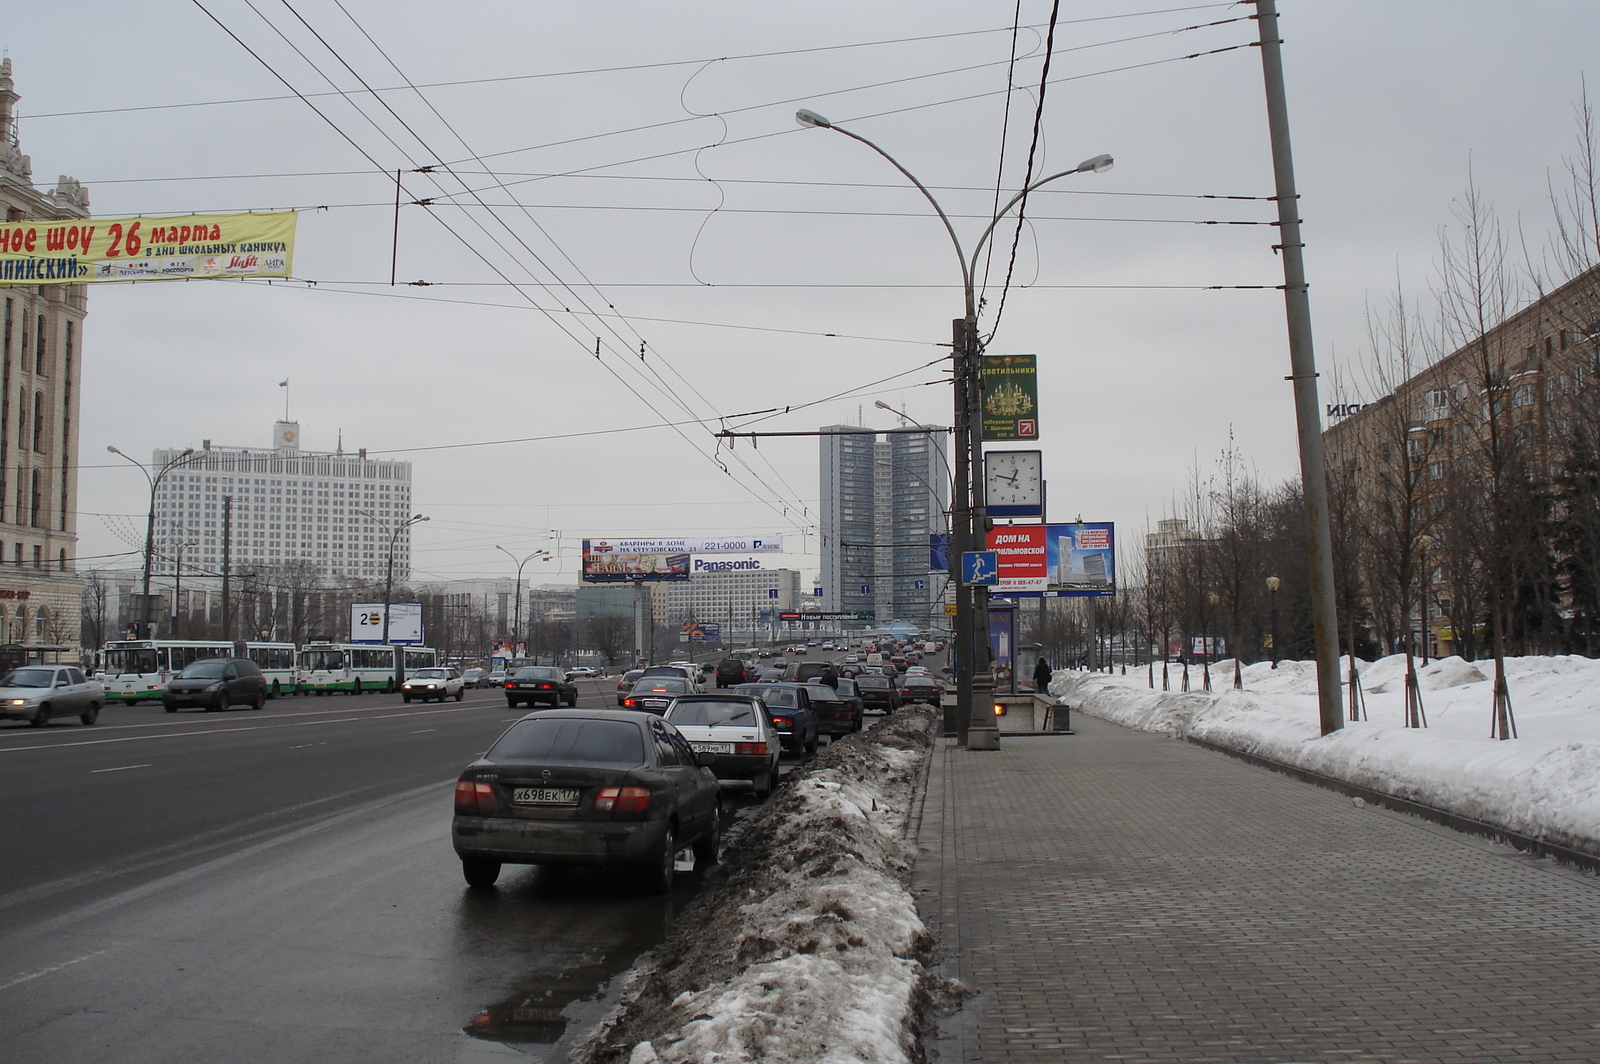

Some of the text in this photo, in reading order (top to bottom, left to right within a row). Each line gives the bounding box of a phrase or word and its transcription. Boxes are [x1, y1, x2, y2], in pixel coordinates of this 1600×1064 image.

[46, 226, 95, 255] шоу
[106, 221, 142, 257] 26
[149, 224, 221, 245] марта
[240, 242, 286, 253] каникул
[0, 254, 88, 280] ПИЙСКИЙ»
[995, 535, 1017, 544] ДОМ
[705, 542, 746, 550] 221-0000
[695, 557, 760, 571] Panasonic
[360, 613, 368, 625] 2
[516, 789, 577, 800] Х698ЕК 177
